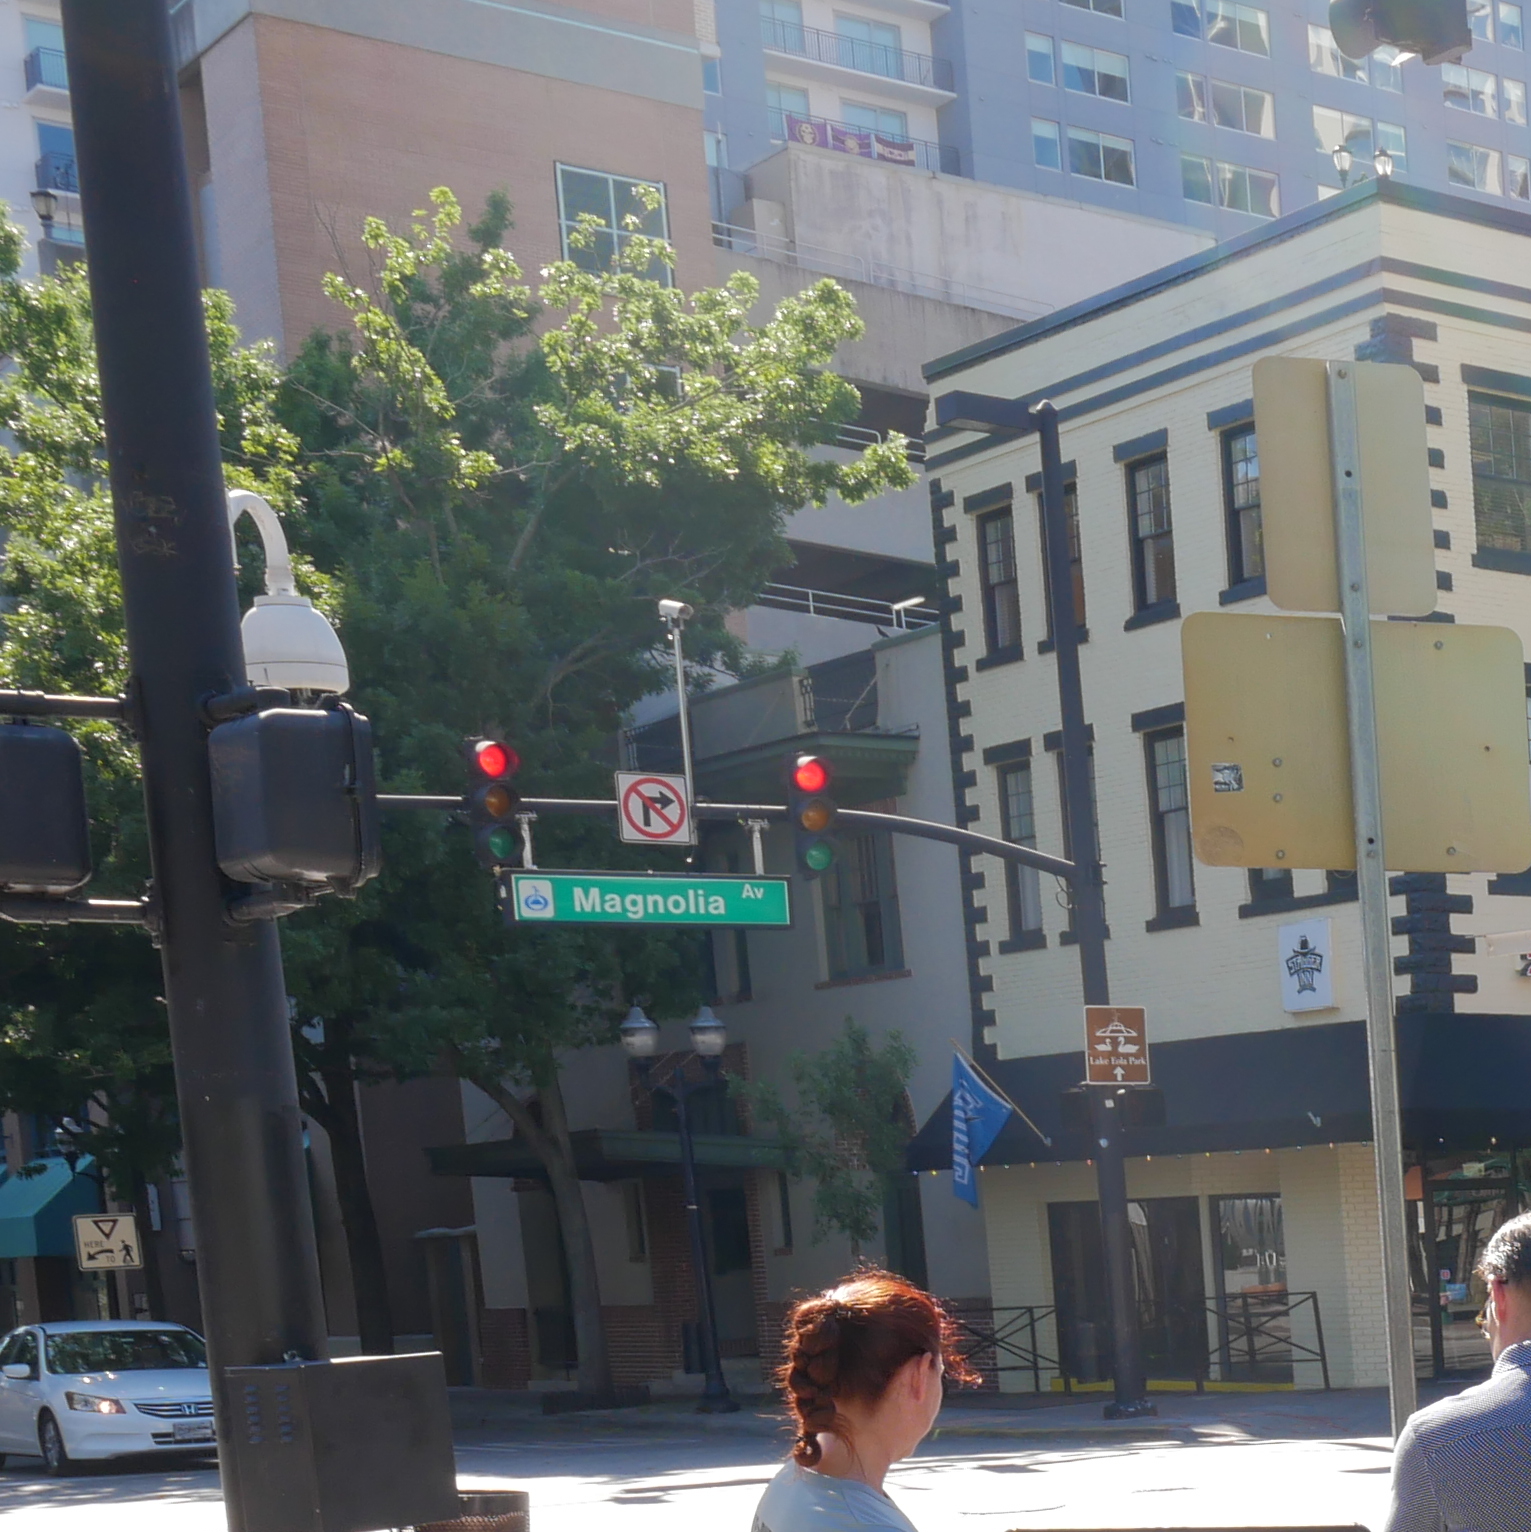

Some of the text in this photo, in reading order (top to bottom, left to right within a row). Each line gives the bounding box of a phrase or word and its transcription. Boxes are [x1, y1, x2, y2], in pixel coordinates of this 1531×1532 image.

[572, 883, 765, 919] Magnolia Av
[1089, 1056, 1147, 1065] Lake Eola Park
[84, 1241, 105, 1249] HERE
[106, 1255, 116, 1263] TO
